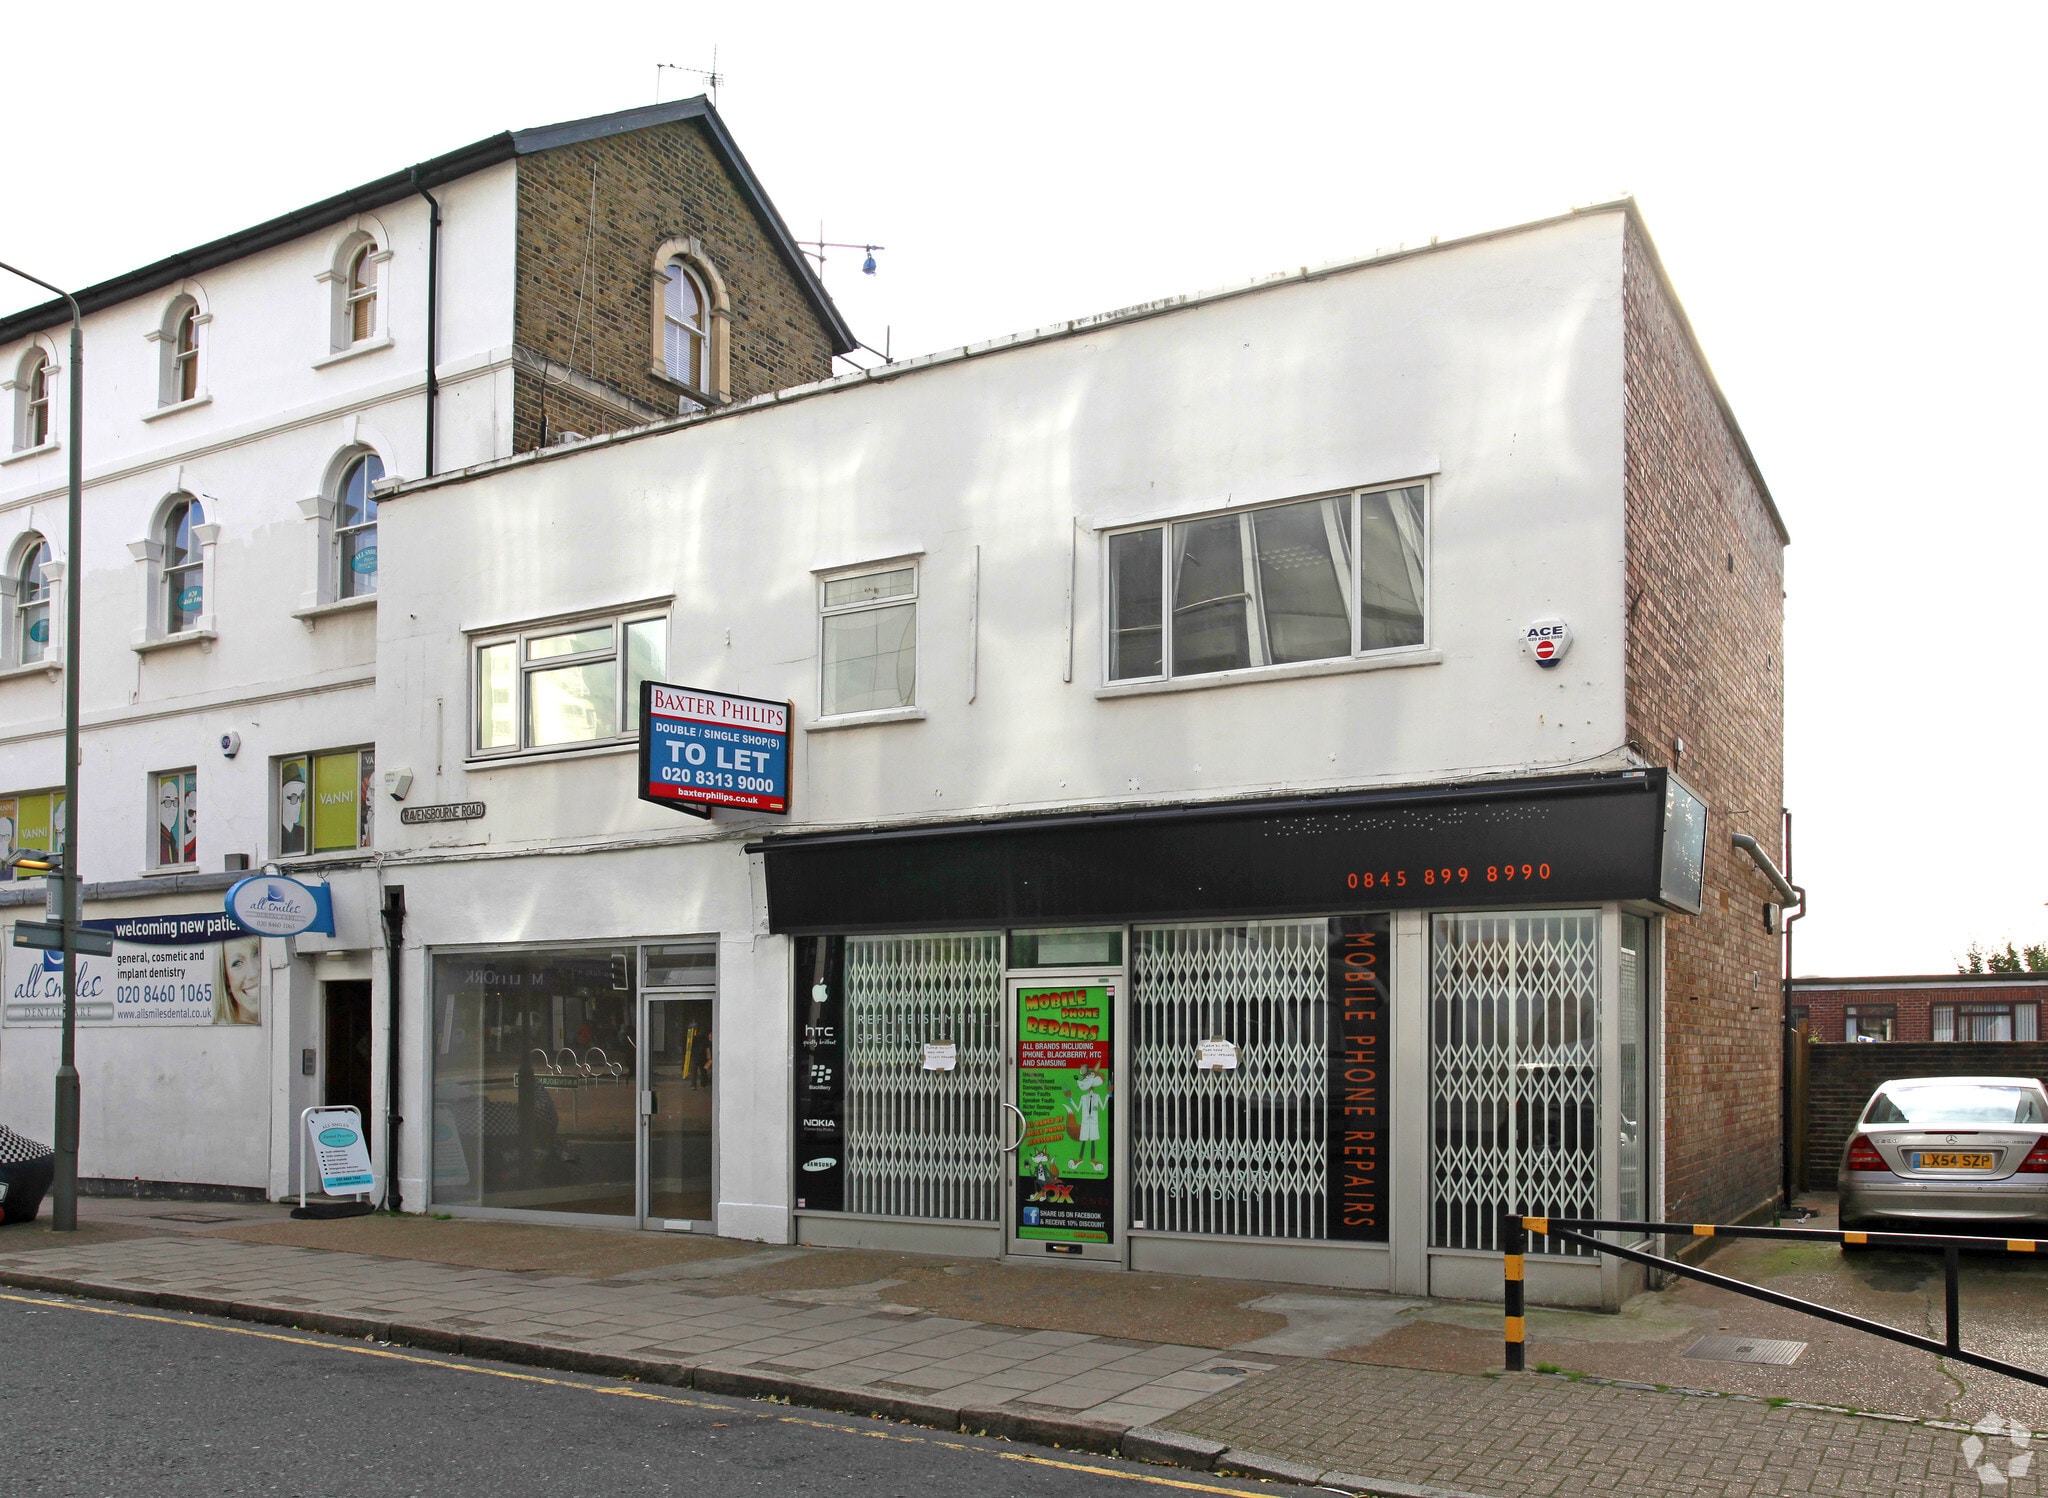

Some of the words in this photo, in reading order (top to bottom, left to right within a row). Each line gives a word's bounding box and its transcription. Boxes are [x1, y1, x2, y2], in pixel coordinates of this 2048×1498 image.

[1527, 625, 1563, 638] ACE
[655, 689, 716, 716] BAXTER
[722, 699, 784, 726] PHILIPS
[656, 722, 696, 737] DOUBLE
[704, 729, 740, 743] SINGLE
[742, 734, 780, 750] SHOP(S)
[665, 739, 706, 766] TO
[717, 746, 770, 774] LET
[662, 766, 691, 783] 020
[696, 770, 733, 788] 8313
[738, 775, 774, 793] 9000
[320, 790, 353, 805] VANNI
[678, 787, 758, 804] baxterphilips.co.uk
[404, 806, 459, 821] RAVENSBOURNE
[461, 804, 481, 817] ROAD
[22, 827, 47, 839] VANNI
[1347, 870, 1407, 889] 0845
[1424, 867, 1469, 885] 899
[1487, 863, 1551, 882] 8990
[250, 897, 267, 909] all
[268, 899, 302, 914] smiles
[116, 918, 176, 939] welcoming
[180, 919, 204, 934] new
[207, 915, 241, 936] patie
[117, 951, 150, 966] general,
[151, 950, 188, 963] cosmetic
[189, 949, 205, 962] and
[14, 962, 43, 999] all
[44, 961, 104, 999] smles
[117, 967, 148, 981] implant
[149, 967, 186, 981] dentistry
[1344, 933, 1376, 1021] MOBILE
[117, 985, 140, 1004] 020
[144, 984, 175, 1003] 8460
[180, 983, 212, 1002] 1065
[1025, 989, 1086, 1011] MOBILE
[75, 1006, 92, 1018] ARE
[117, 1008, 212, 1020] www.allsmilesdental.co.uk
[1061, 1007, 1099, 1018] PHONE
[1026, 1016, 1099, 1041] REPAIRS
[1022, 1042, 1034, 1050] ALL
[1035, 1042, 1060, 1050] BRANDS
[1061, 1042, 1094, 1050] INCLUDING
[1022, 1051, 1046, 1059] IPHONE,
[1047, 1051, 1088, 1059] BLACKBERRY,
[1022, 1059, 1035, 1067] AND
[1036, 1059, 1067, 1067] SAMSUNG
[1344, 1036, 1376, 1116] PHONE
[803, 1119, 835, 1127] NOKIA
[1922, 1156, 1958, 1166] LX54
[1962, 1156, 1990, 1167] SZP
[1343, 1131, 1376, 1226] REPAIRS
[1170, 1187, 1199, 1199] SIM
[1212, 1189, 1262, 1202] ONLY
[1074, 1212, 1101, 1220] FACEBOOK
[1079, 1220, 1105, 1228] DISCOUNT
